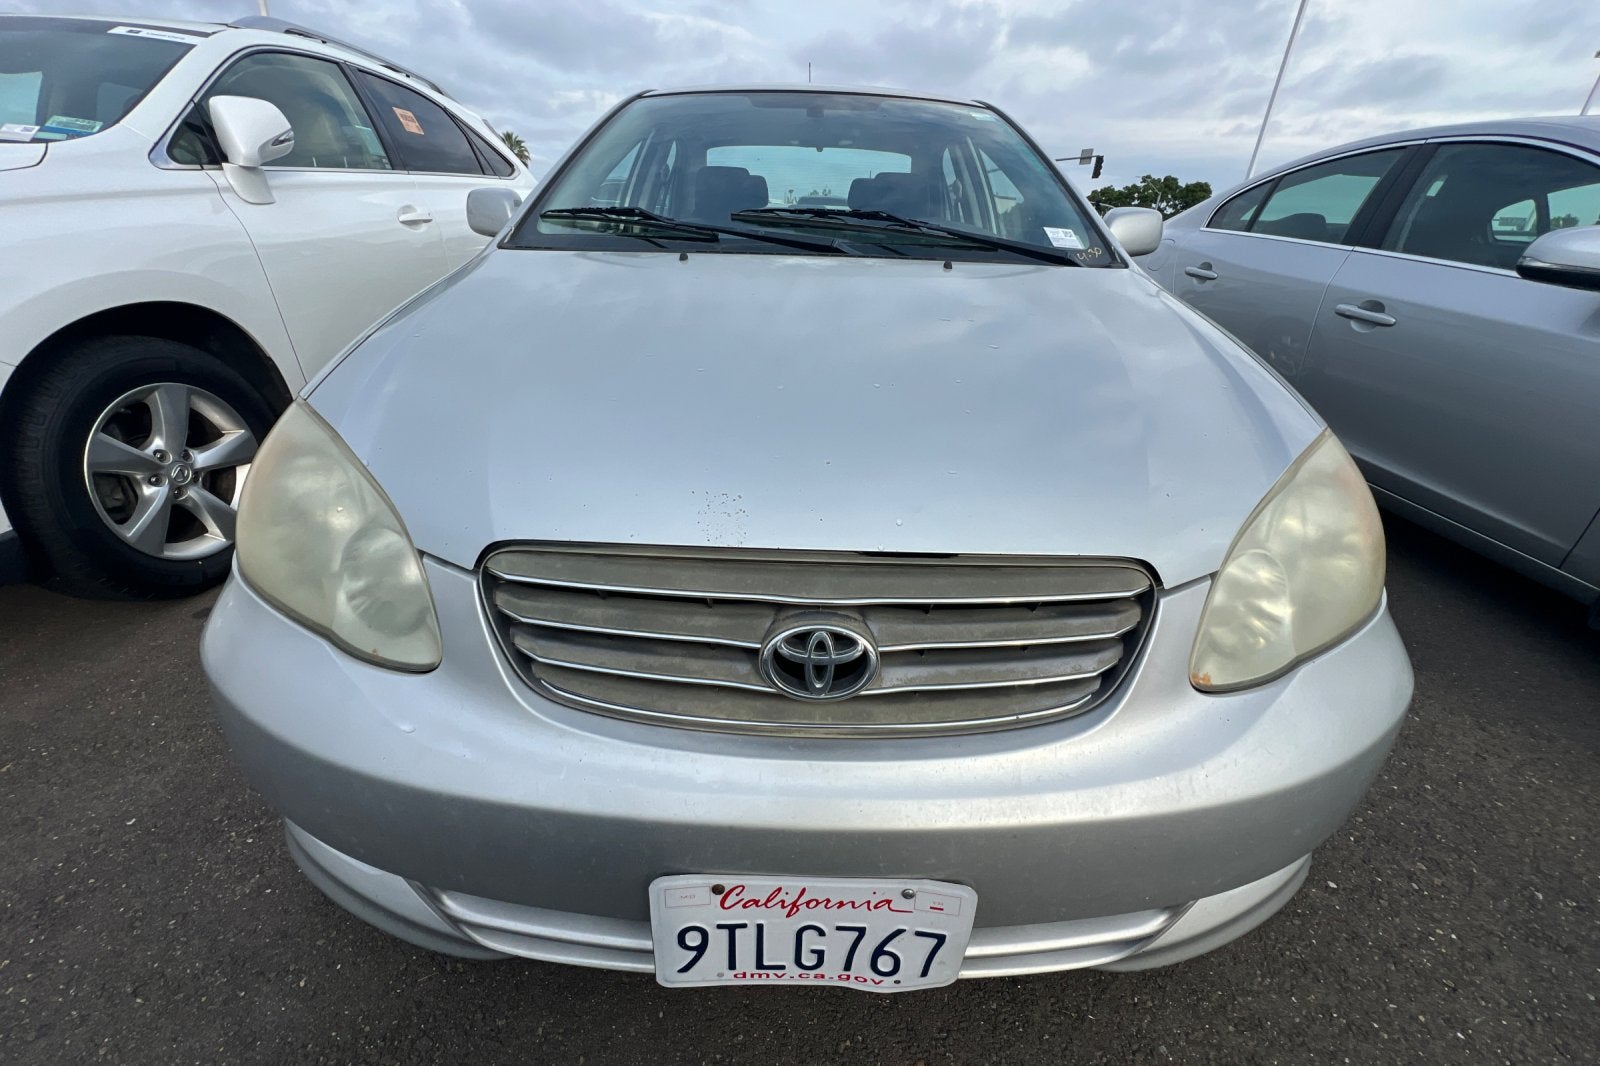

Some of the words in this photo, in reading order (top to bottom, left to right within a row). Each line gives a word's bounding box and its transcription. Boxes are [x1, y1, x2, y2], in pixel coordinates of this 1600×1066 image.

[719, 884, 914, 918] California
[677, 923, 947, 978] 9TLG767
[733, 971, 884, 985] dmv.ca.gov
